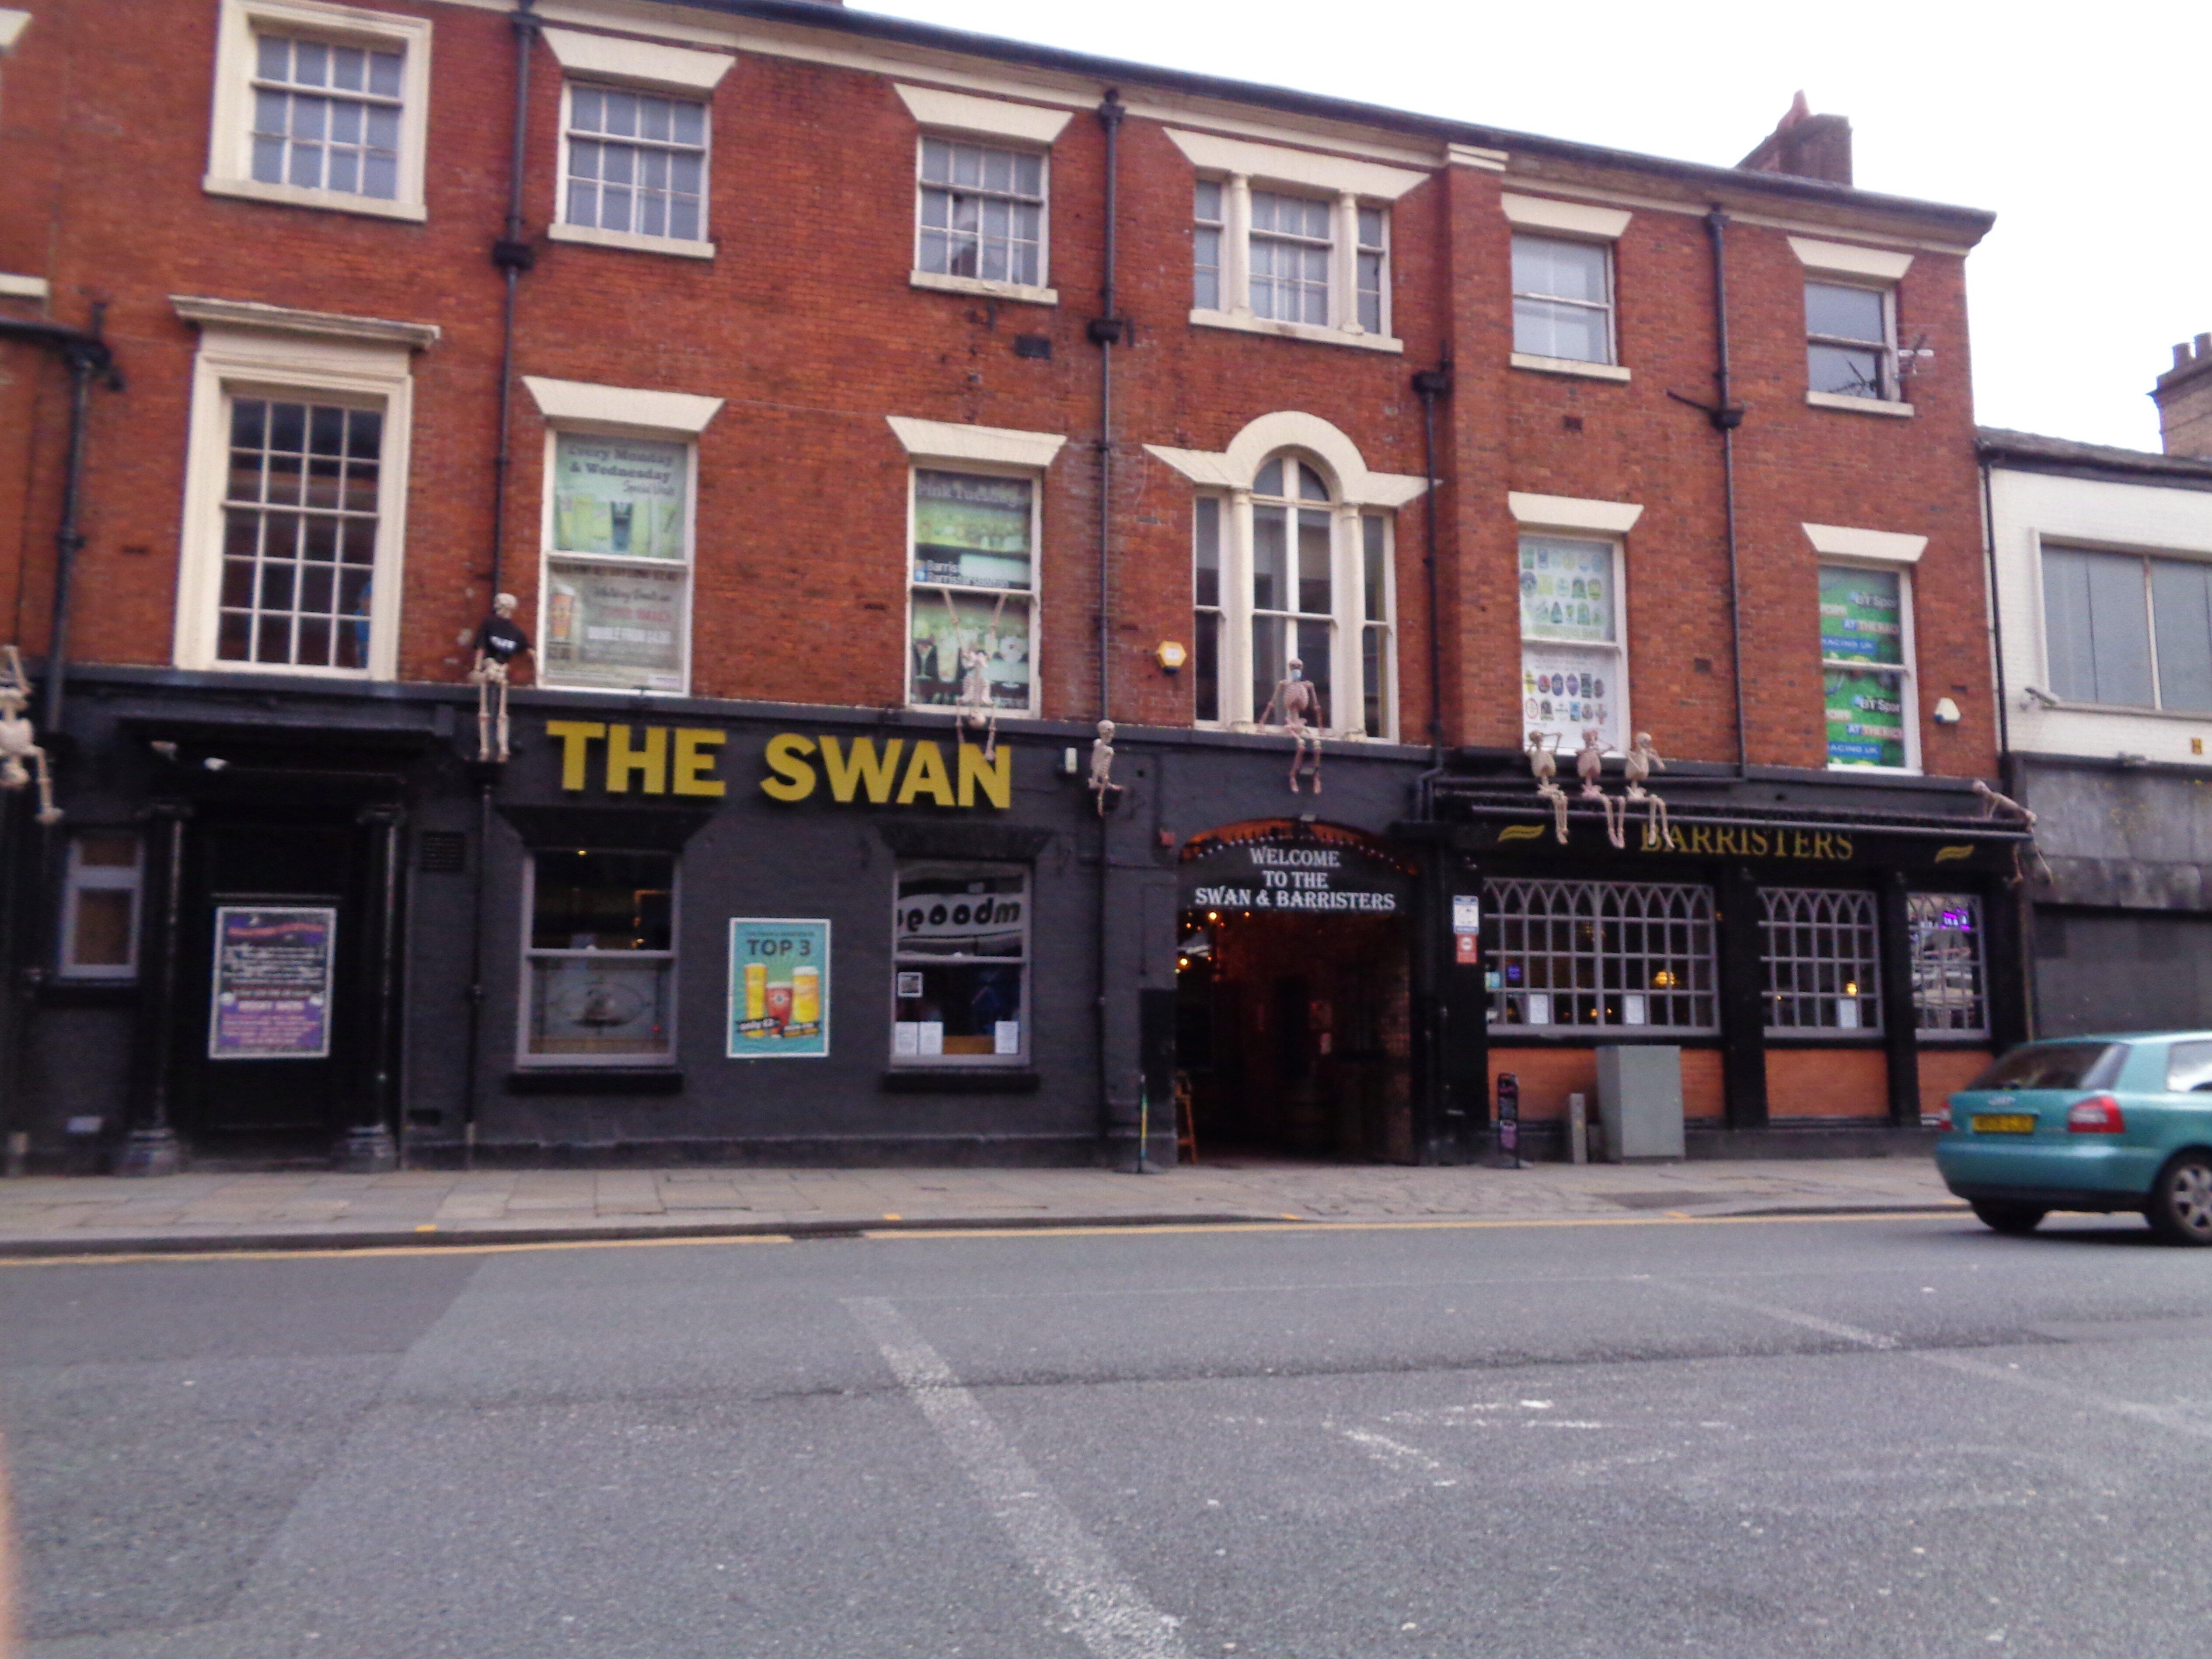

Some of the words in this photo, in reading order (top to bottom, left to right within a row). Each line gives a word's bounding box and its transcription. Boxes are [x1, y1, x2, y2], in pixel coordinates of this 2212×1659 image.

[570, 461, 582, 473] &
[586, 463, 670, 483] Wednesday
[546, 720, 727, 797] THE
[759, 733, 1011, 809] SWAN
[1640, 820, 1853, 860] BARRISTERS
[1250, 845, 1341, 868] WELCOME
[1262, 870, 1287, 888] TO
[1291, 871, 1329, 890] THE
[1194, 885, 1252, 906] SWAN
[1256, 890, 1271, 907] &
[1276, 890, 1397, 911] BARRISTERS
[746, 939, 793, 956] TOP
[799, 940, 810, 956] 3
